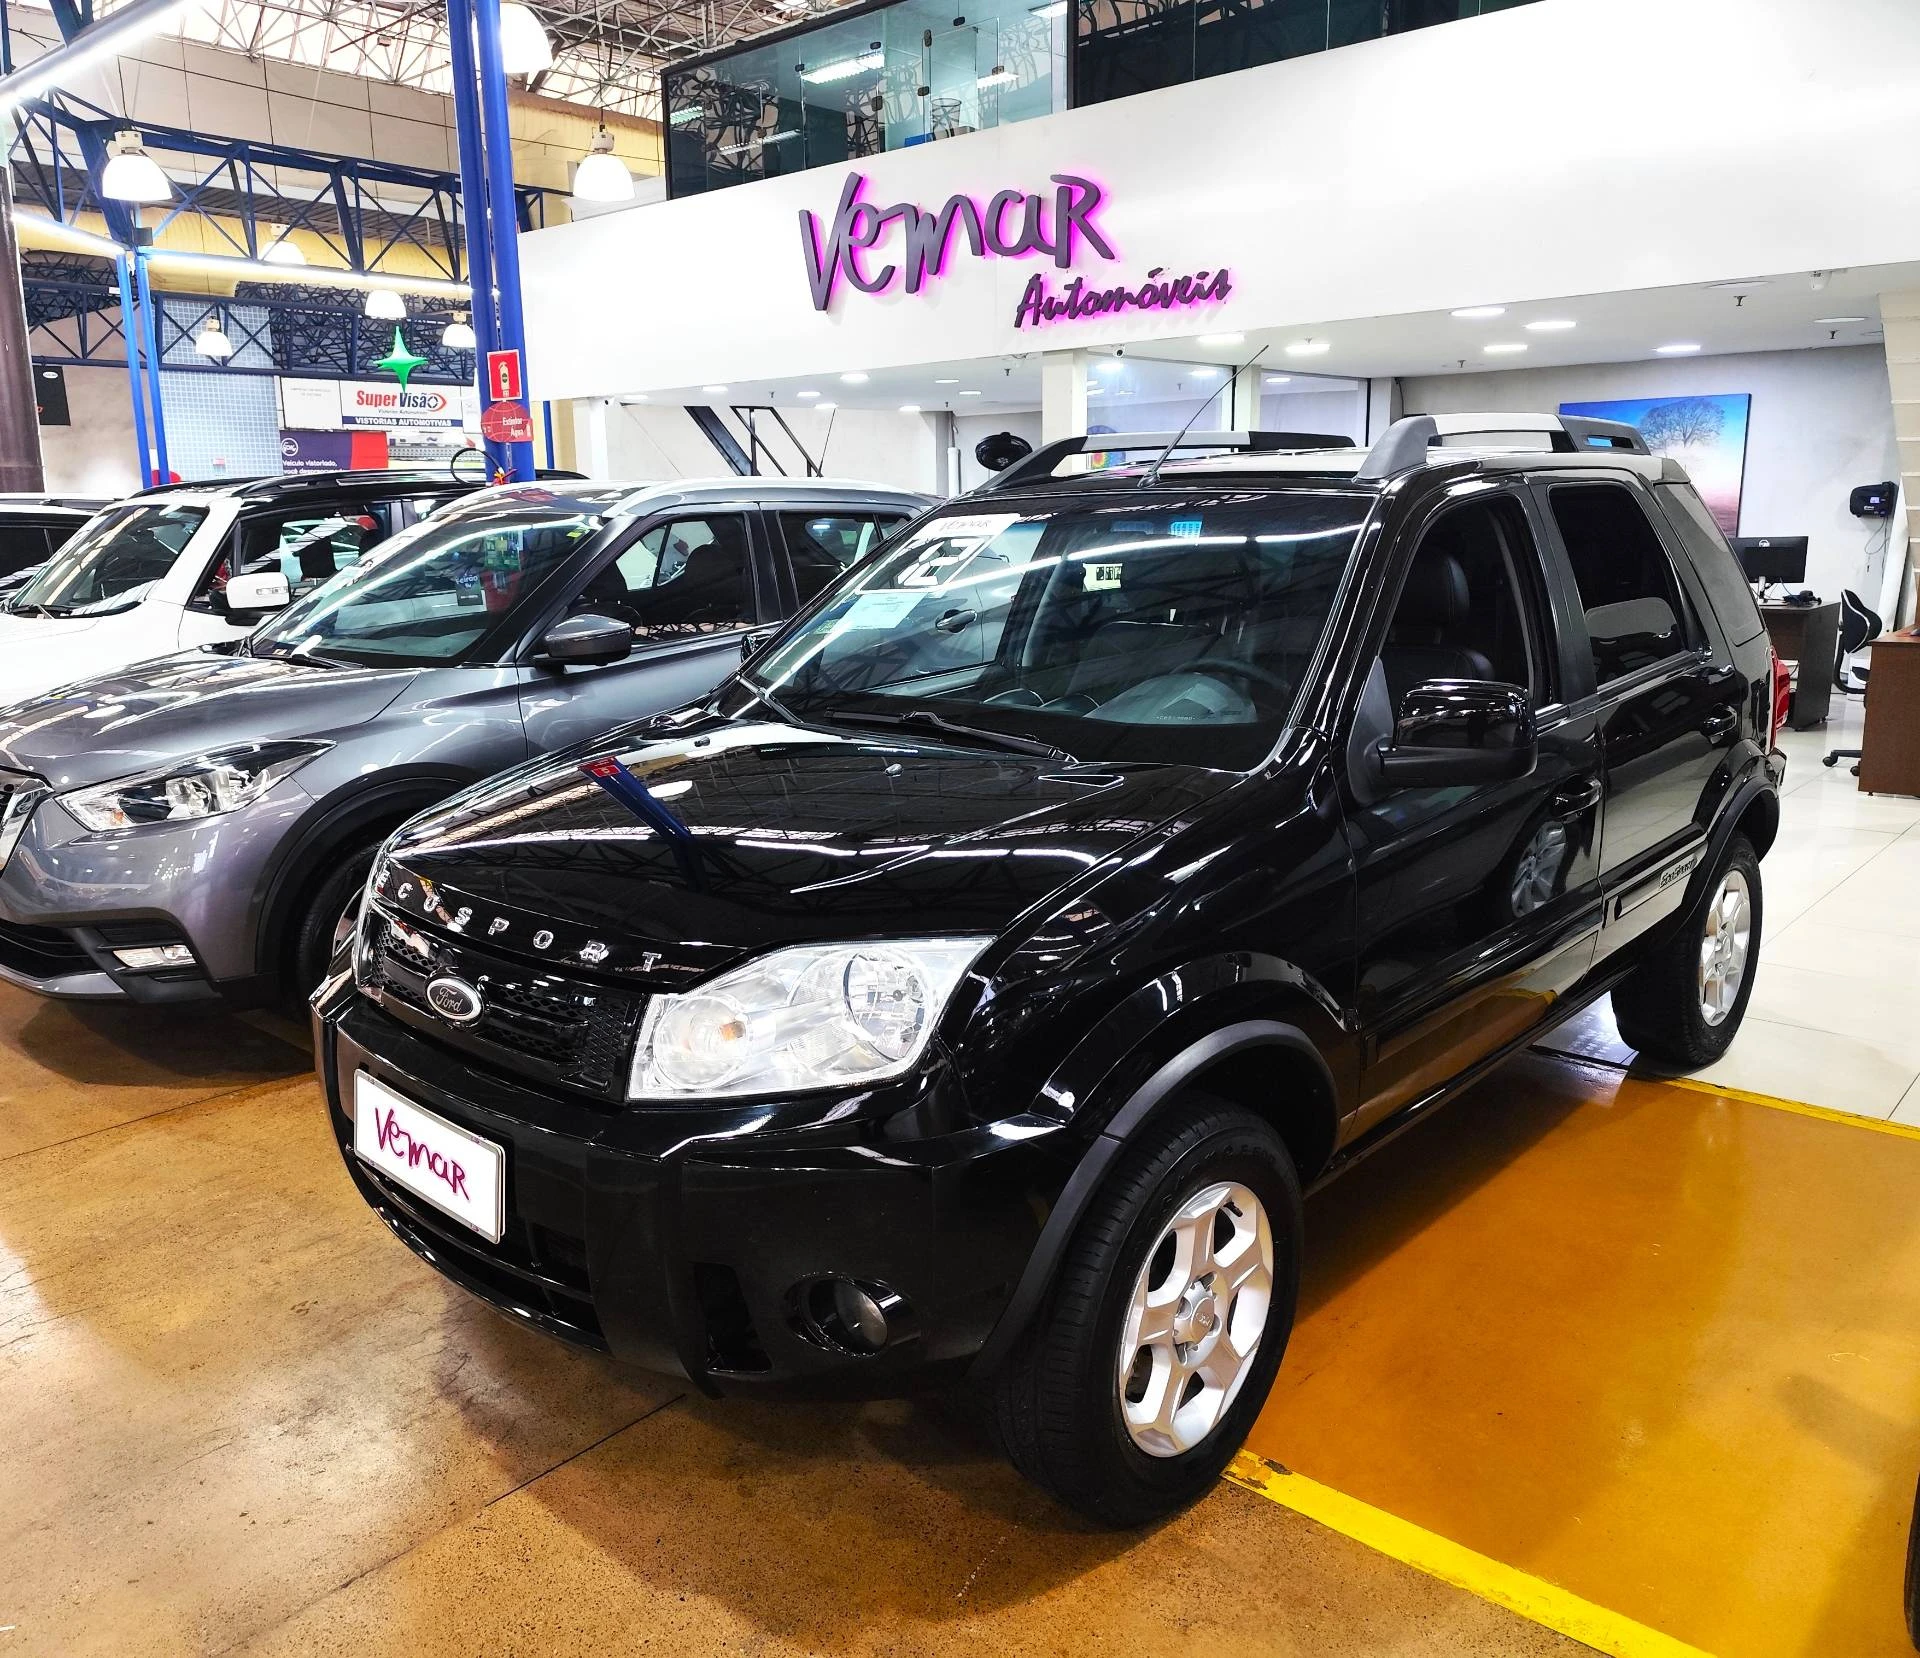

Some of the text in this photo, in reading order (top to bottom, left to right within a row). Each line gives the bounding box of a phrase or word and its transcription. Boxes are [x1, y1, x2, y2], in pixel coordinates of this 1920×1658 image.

[1014, 268, 1232, 328] Automóveis
[356, 390, 397, 408] Super
[355, 417, 452, 427] VISTORIAS AUTOMOTIVAS
[376, 868, 662, 973] ECOSPORT
[435, 987, 464, 1014] Ford
